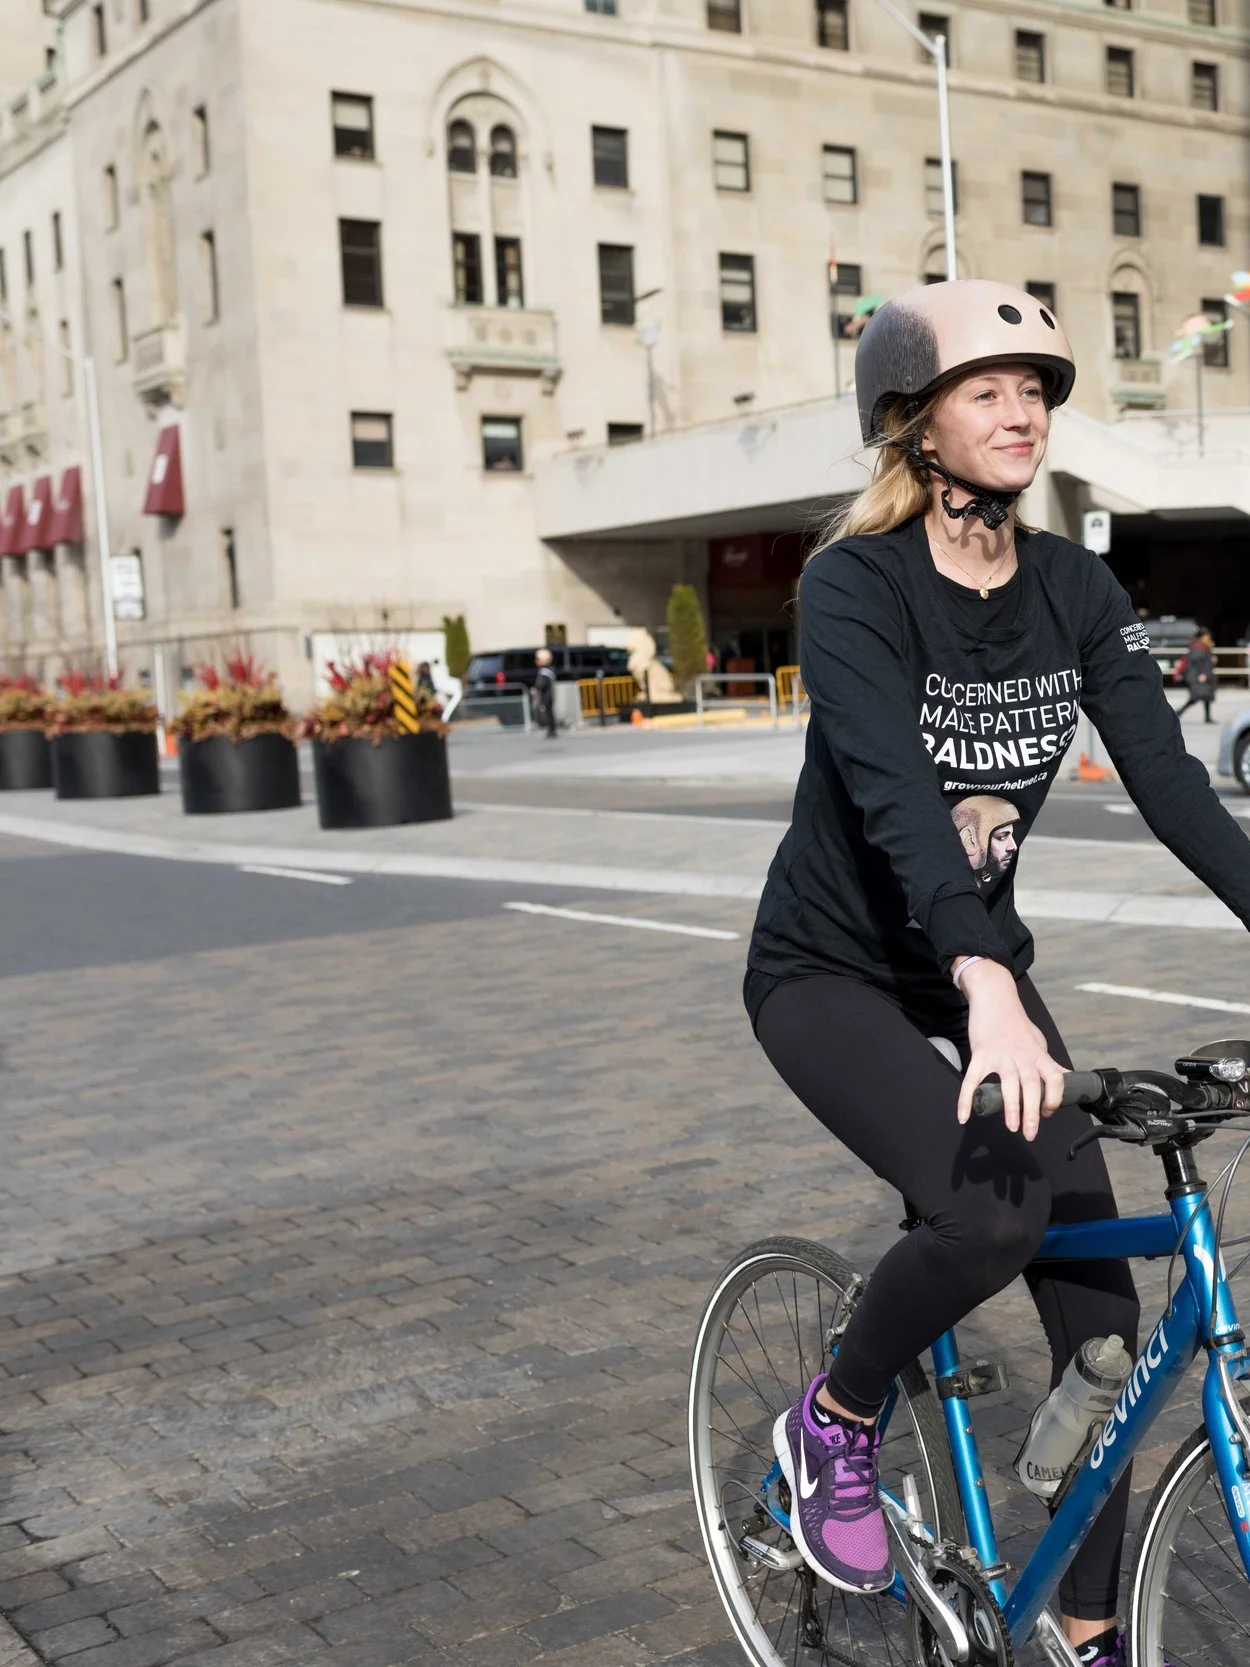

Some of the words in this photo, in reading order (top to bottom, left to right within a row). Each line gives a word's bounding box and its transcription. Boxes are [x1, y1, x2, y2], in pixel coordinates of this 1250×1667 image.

[926, 673, 1032, 706] COCERNED
[1035, 669, 1083, 698] WITH
[919, 703, 977, 735] MALE
[979, 697, 1081, 736] PATTERN
[943, 771, 1048, 791] growyourhelmet.ca
[1090, 1319, 1169, 1470] devinci
[1026, 1461, 1066, 1479] CAMEL
